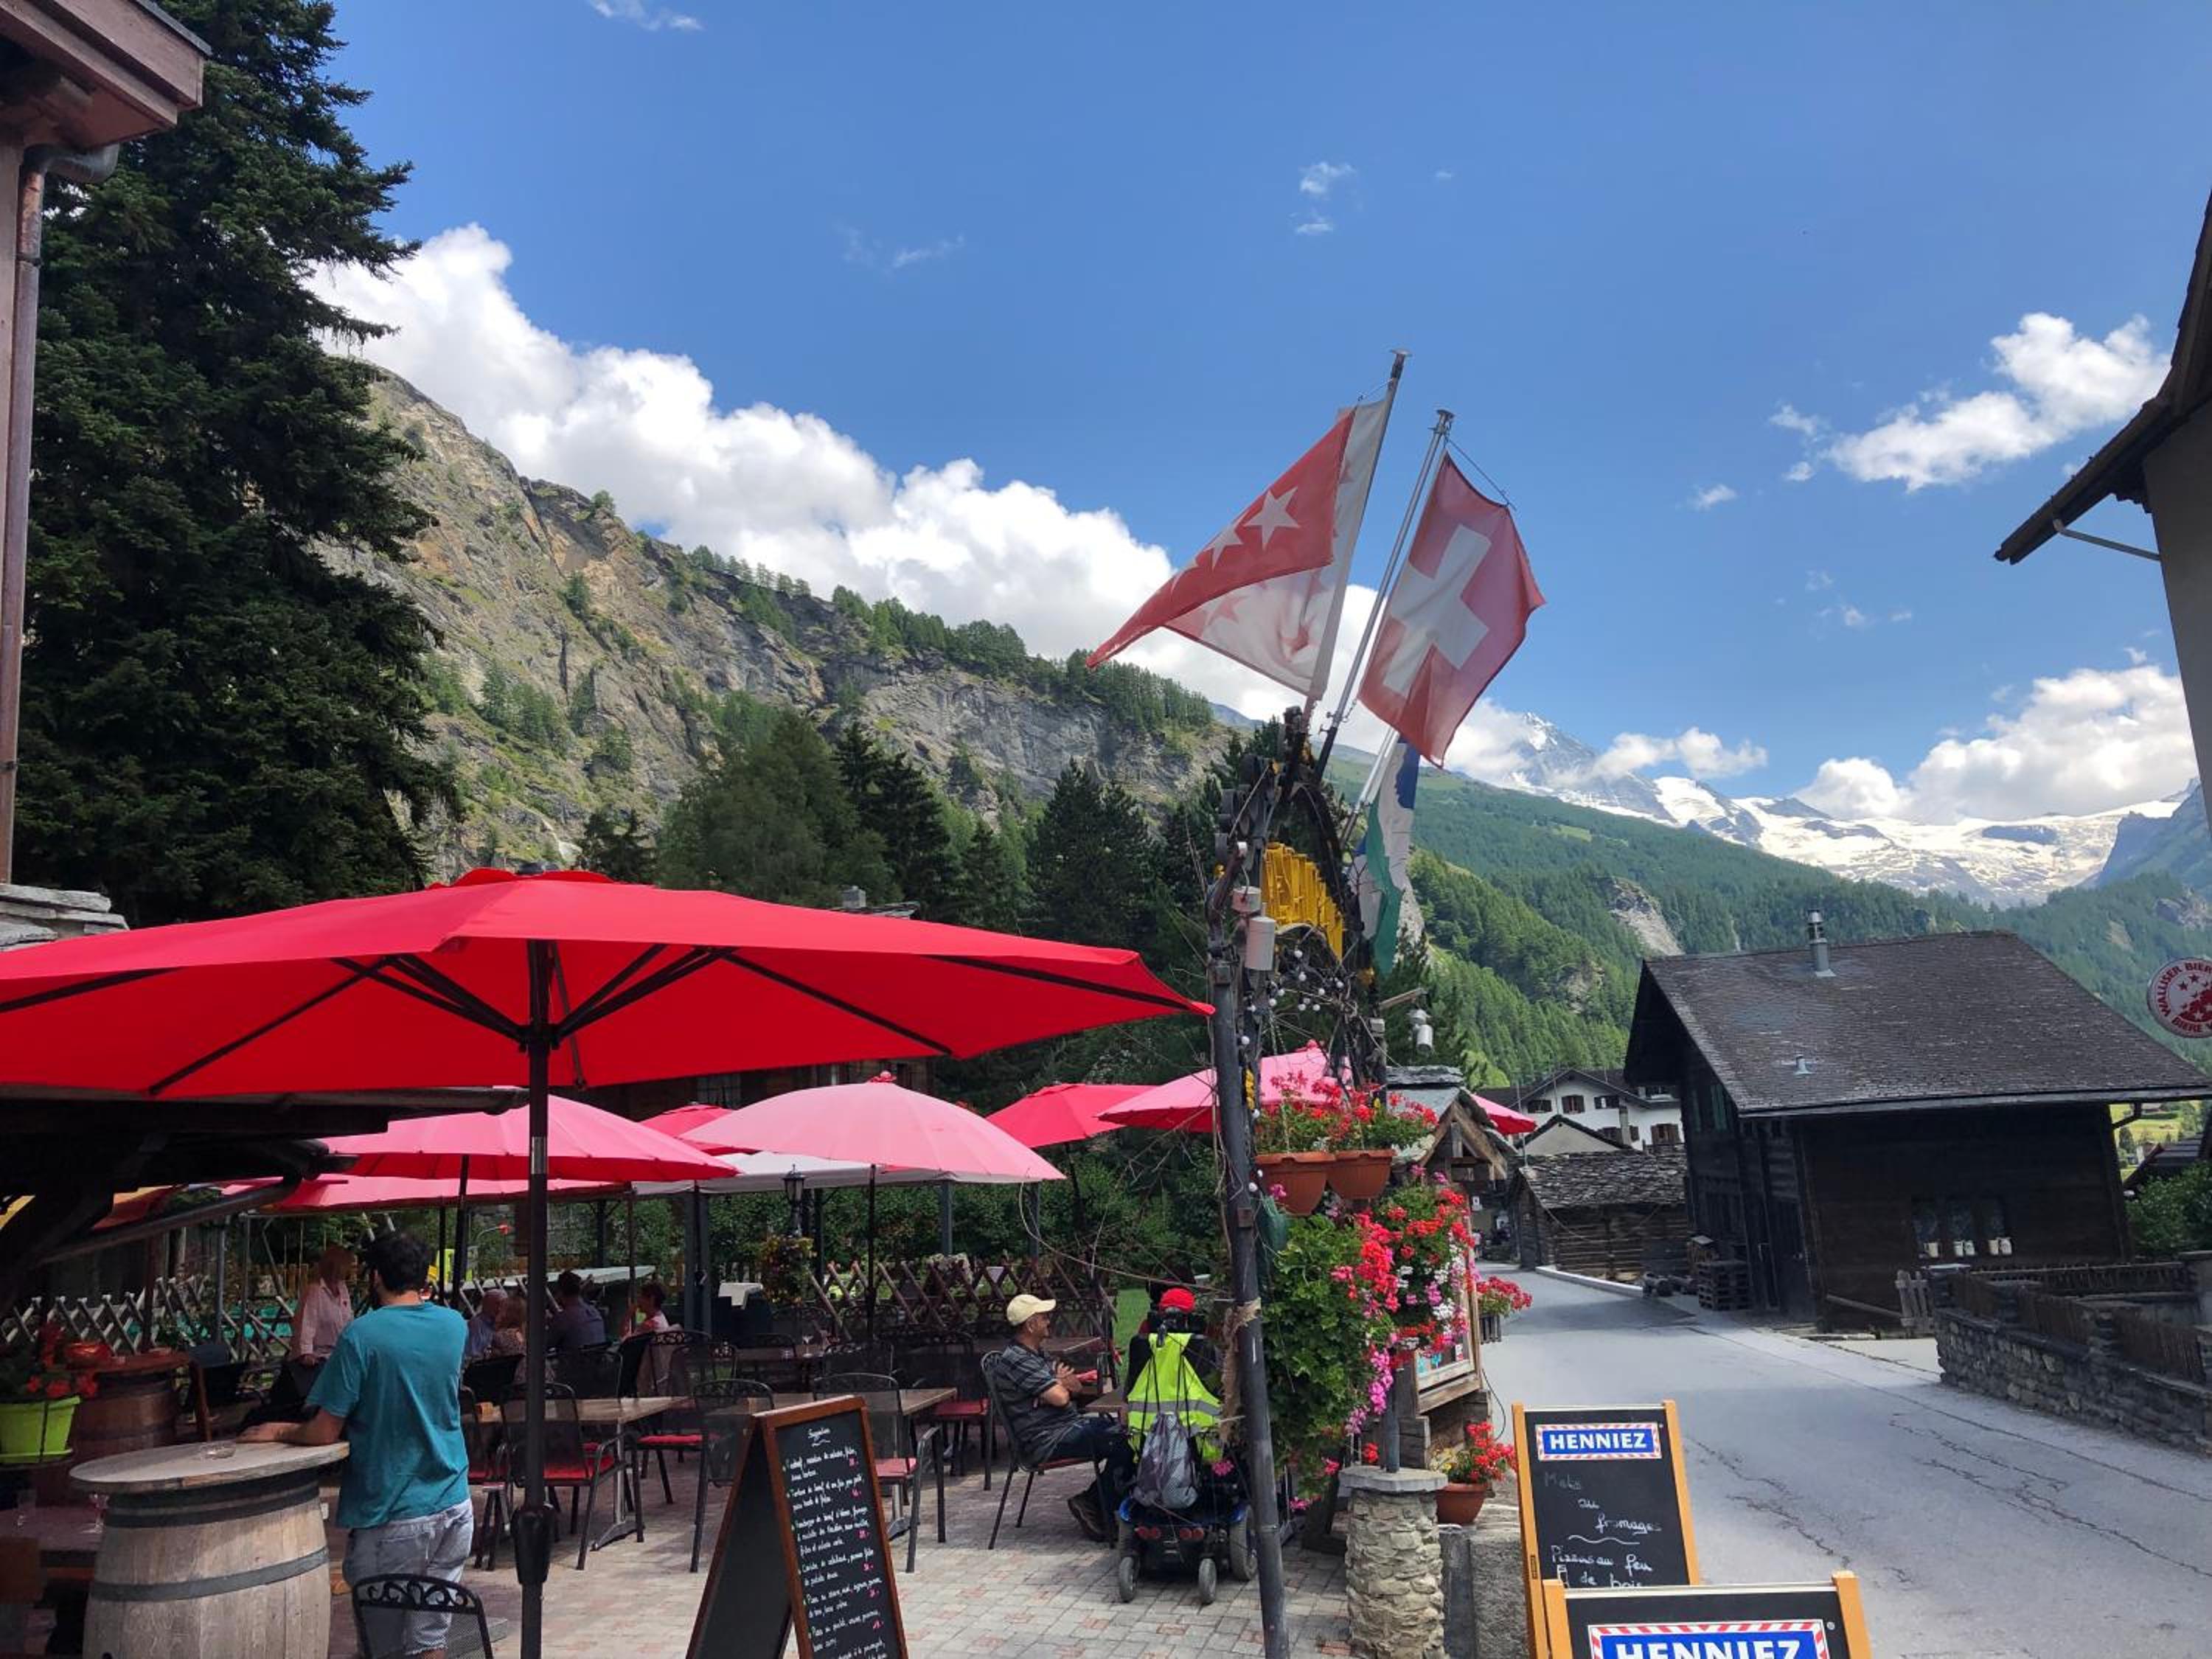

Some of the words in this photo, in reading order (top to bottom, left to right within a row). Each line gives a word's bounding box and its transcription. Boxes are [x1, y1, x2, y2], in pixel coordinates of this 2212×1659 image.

[2157, 965, 2183, 1017] WALLISER
[1550, 1433, 1646, 1450] HENNIEZ
[1578, 1498, 1600, 1509] au
[1596, 1557, 1613, 1565] au
[1625, 1554, 1652, 1576] feu
[1581, 1571, 1597, 1585] de
